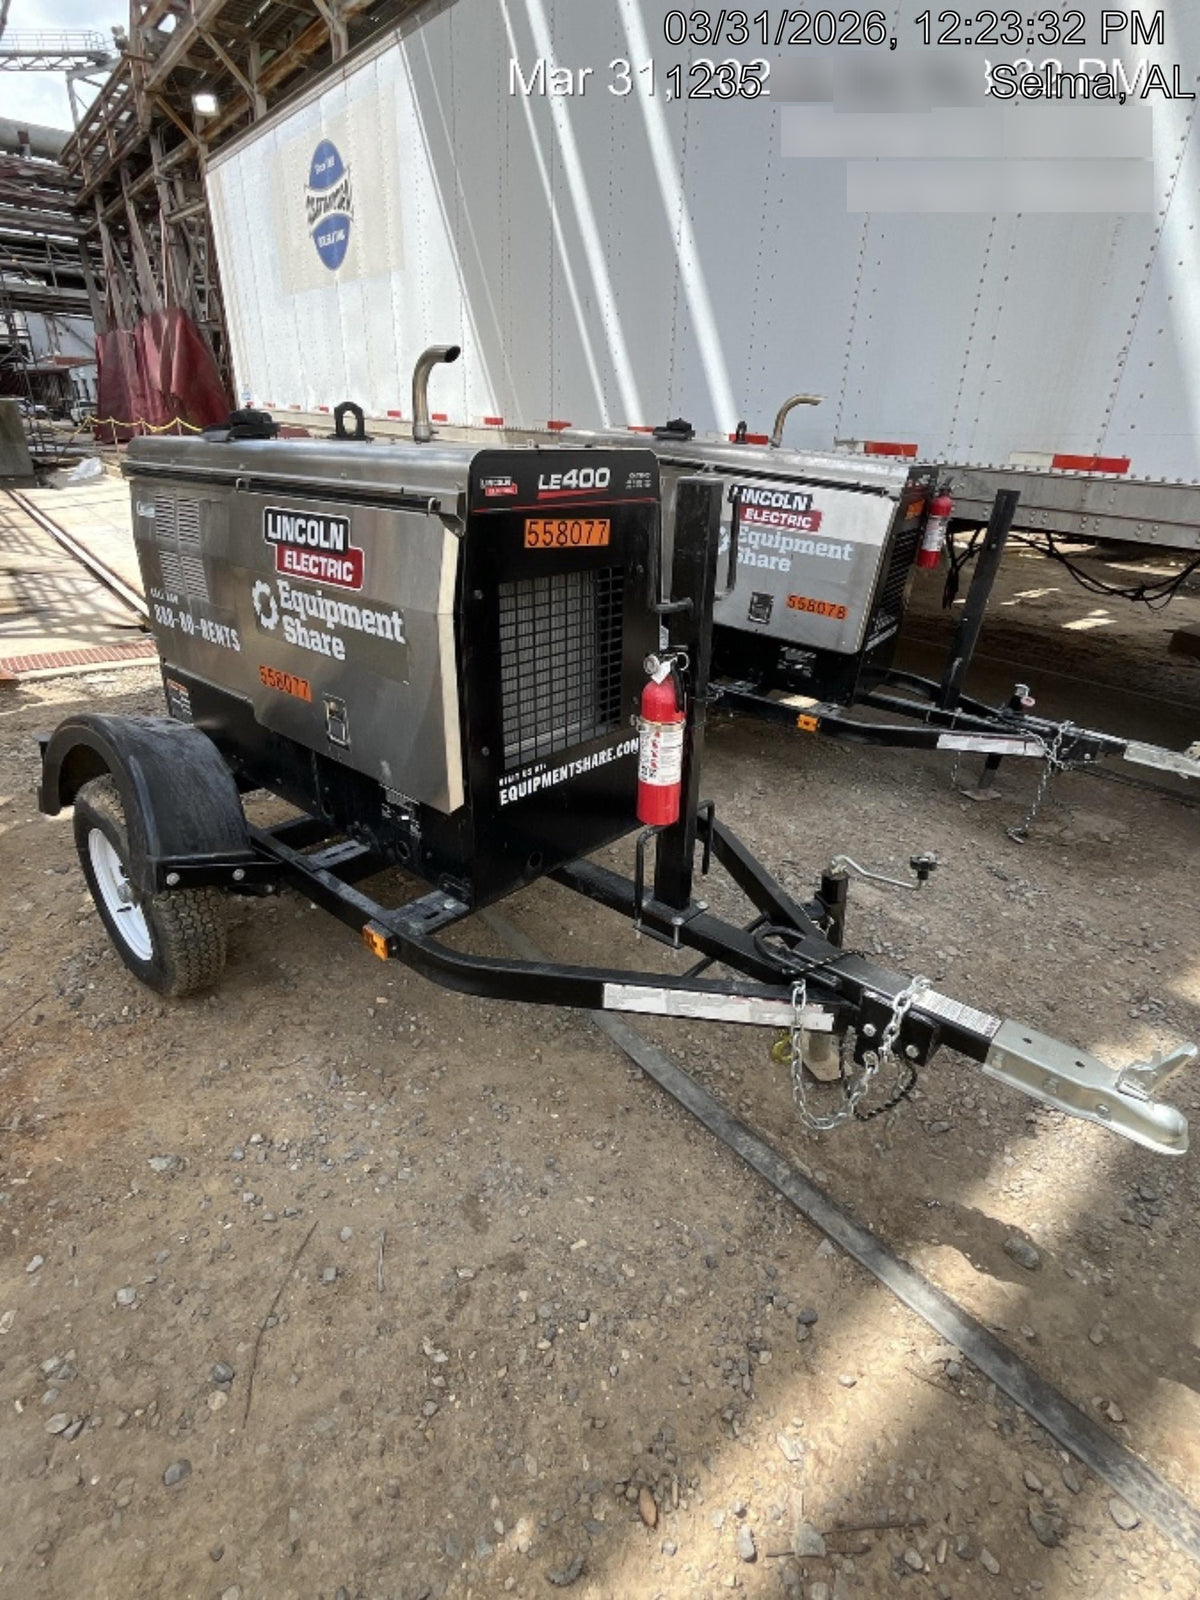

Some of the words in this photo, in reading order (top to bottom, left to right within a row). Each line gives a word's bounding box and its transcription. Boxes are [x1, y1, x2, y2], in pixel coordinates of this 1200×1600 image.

[538, 467, 611, 490] LE400
[267, 513, 345, 551] LINCOLN
[527, 520, 607, 546] 558077
[744, 508, 812, 529] ELECTRIC
[284, 550, 354, 583] ELECTRIC
[276, 579, 406, 645] Equipment
[787, 595, 846, 620] 558078
[282, 616, 346, 661] Share
[258, 664, 310, 700] 558077
